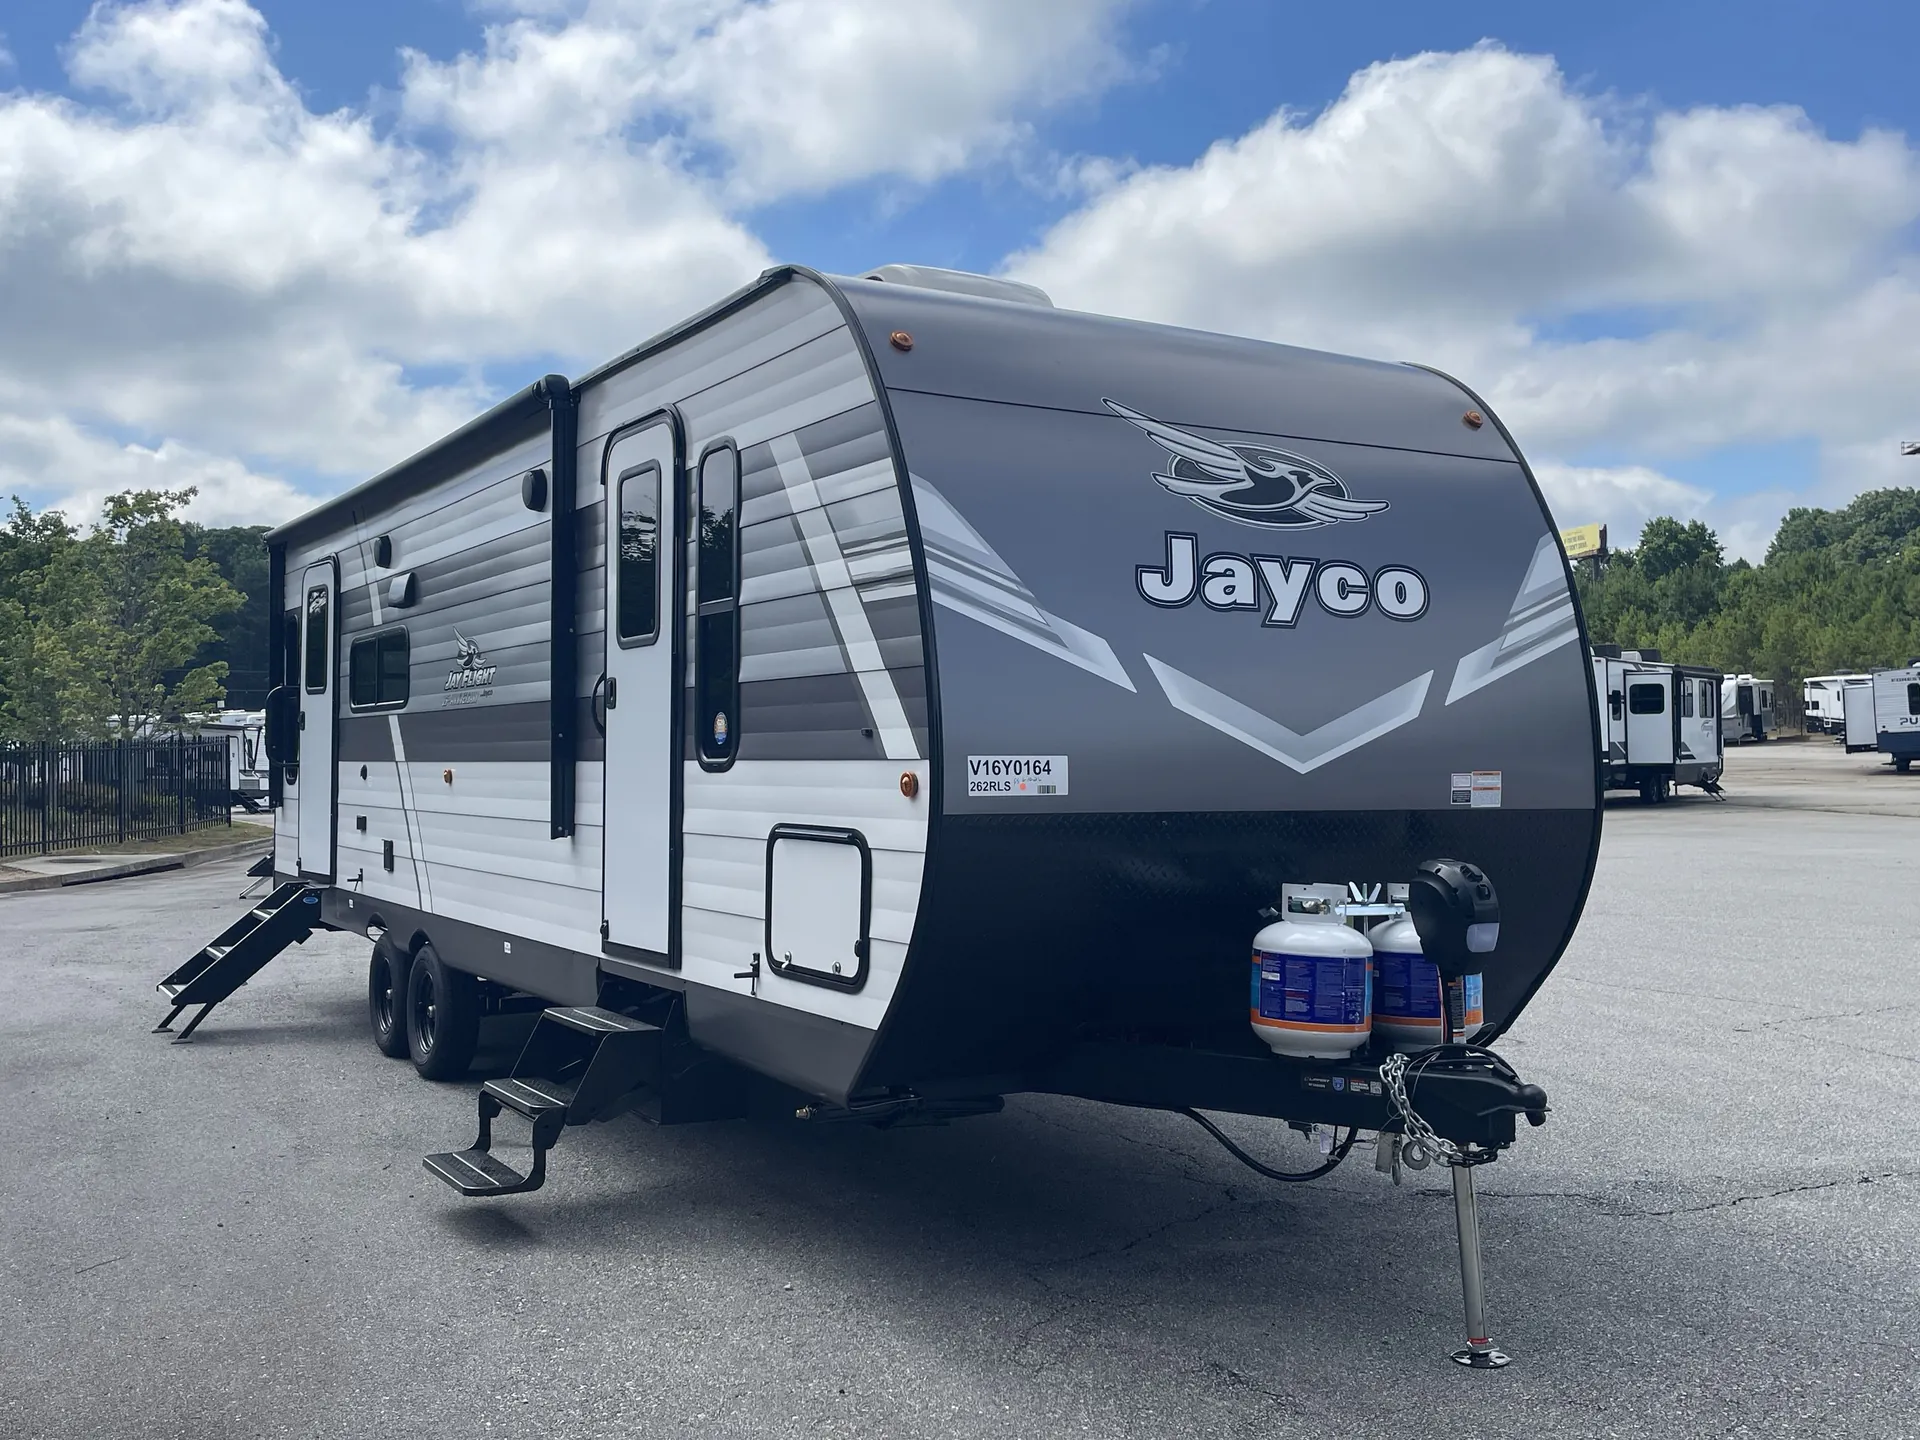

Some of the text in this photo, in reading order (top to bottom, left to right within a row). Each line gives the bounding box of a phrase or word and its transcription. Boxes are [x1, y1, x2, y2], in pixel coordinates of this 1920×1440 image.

[1136, 531, 1430, 629] Jayco
[444, 665, 497, 691] JAY FLIGHT
[969, 759, 1052, 776] V16Y0164
[970, 781, 1011, 792] 262RLS
